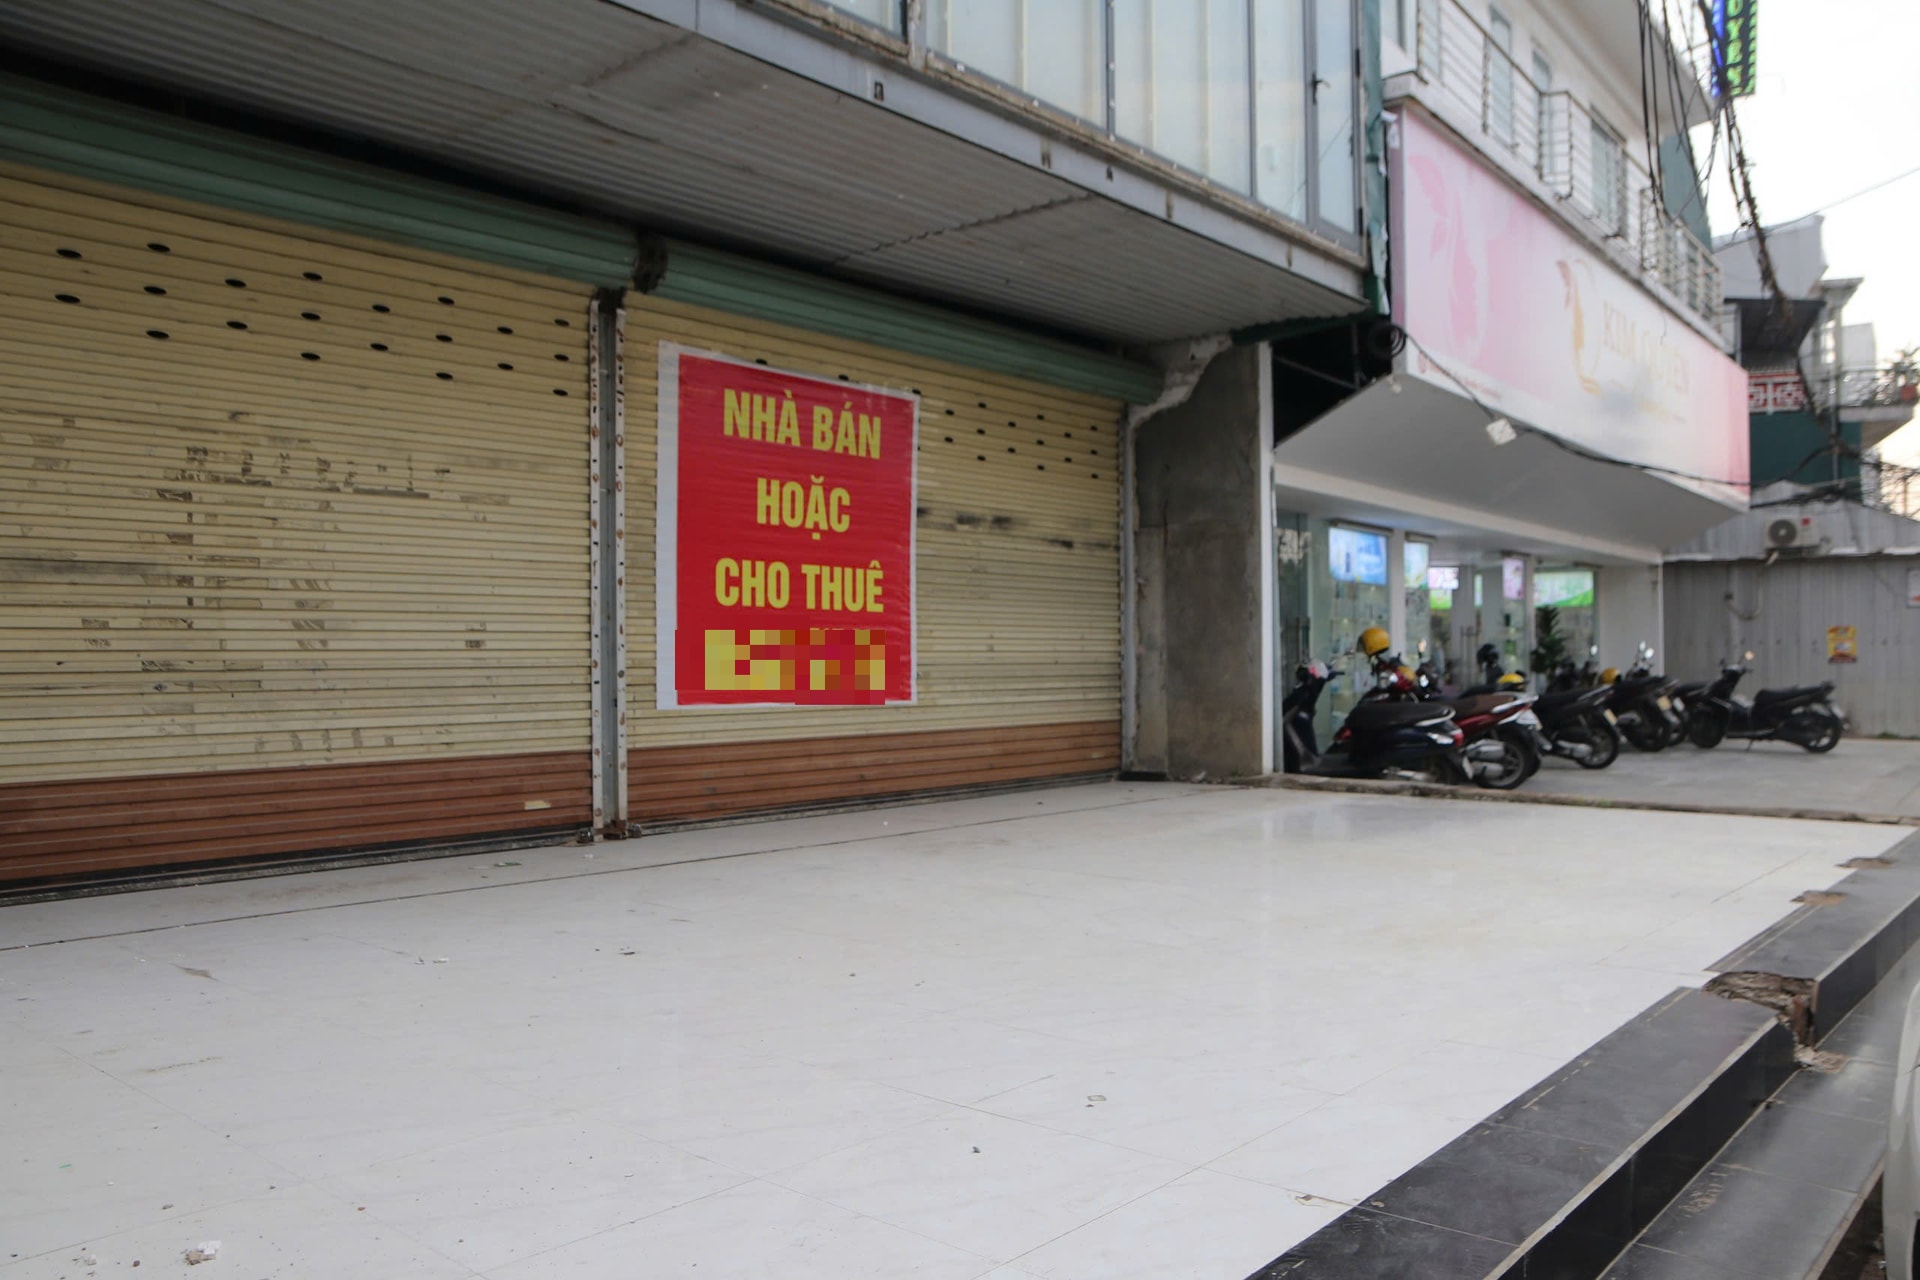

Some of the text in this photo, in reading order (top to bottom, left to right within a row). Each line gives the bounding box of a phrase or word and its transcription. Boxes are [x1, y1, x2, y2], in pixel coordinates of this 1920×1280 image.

[723, 388, 881, 460] NHÀ BÁN
[756, 474, 851, 541] HOẶC
[715, 557, 884, 613] CHO THUÊ
